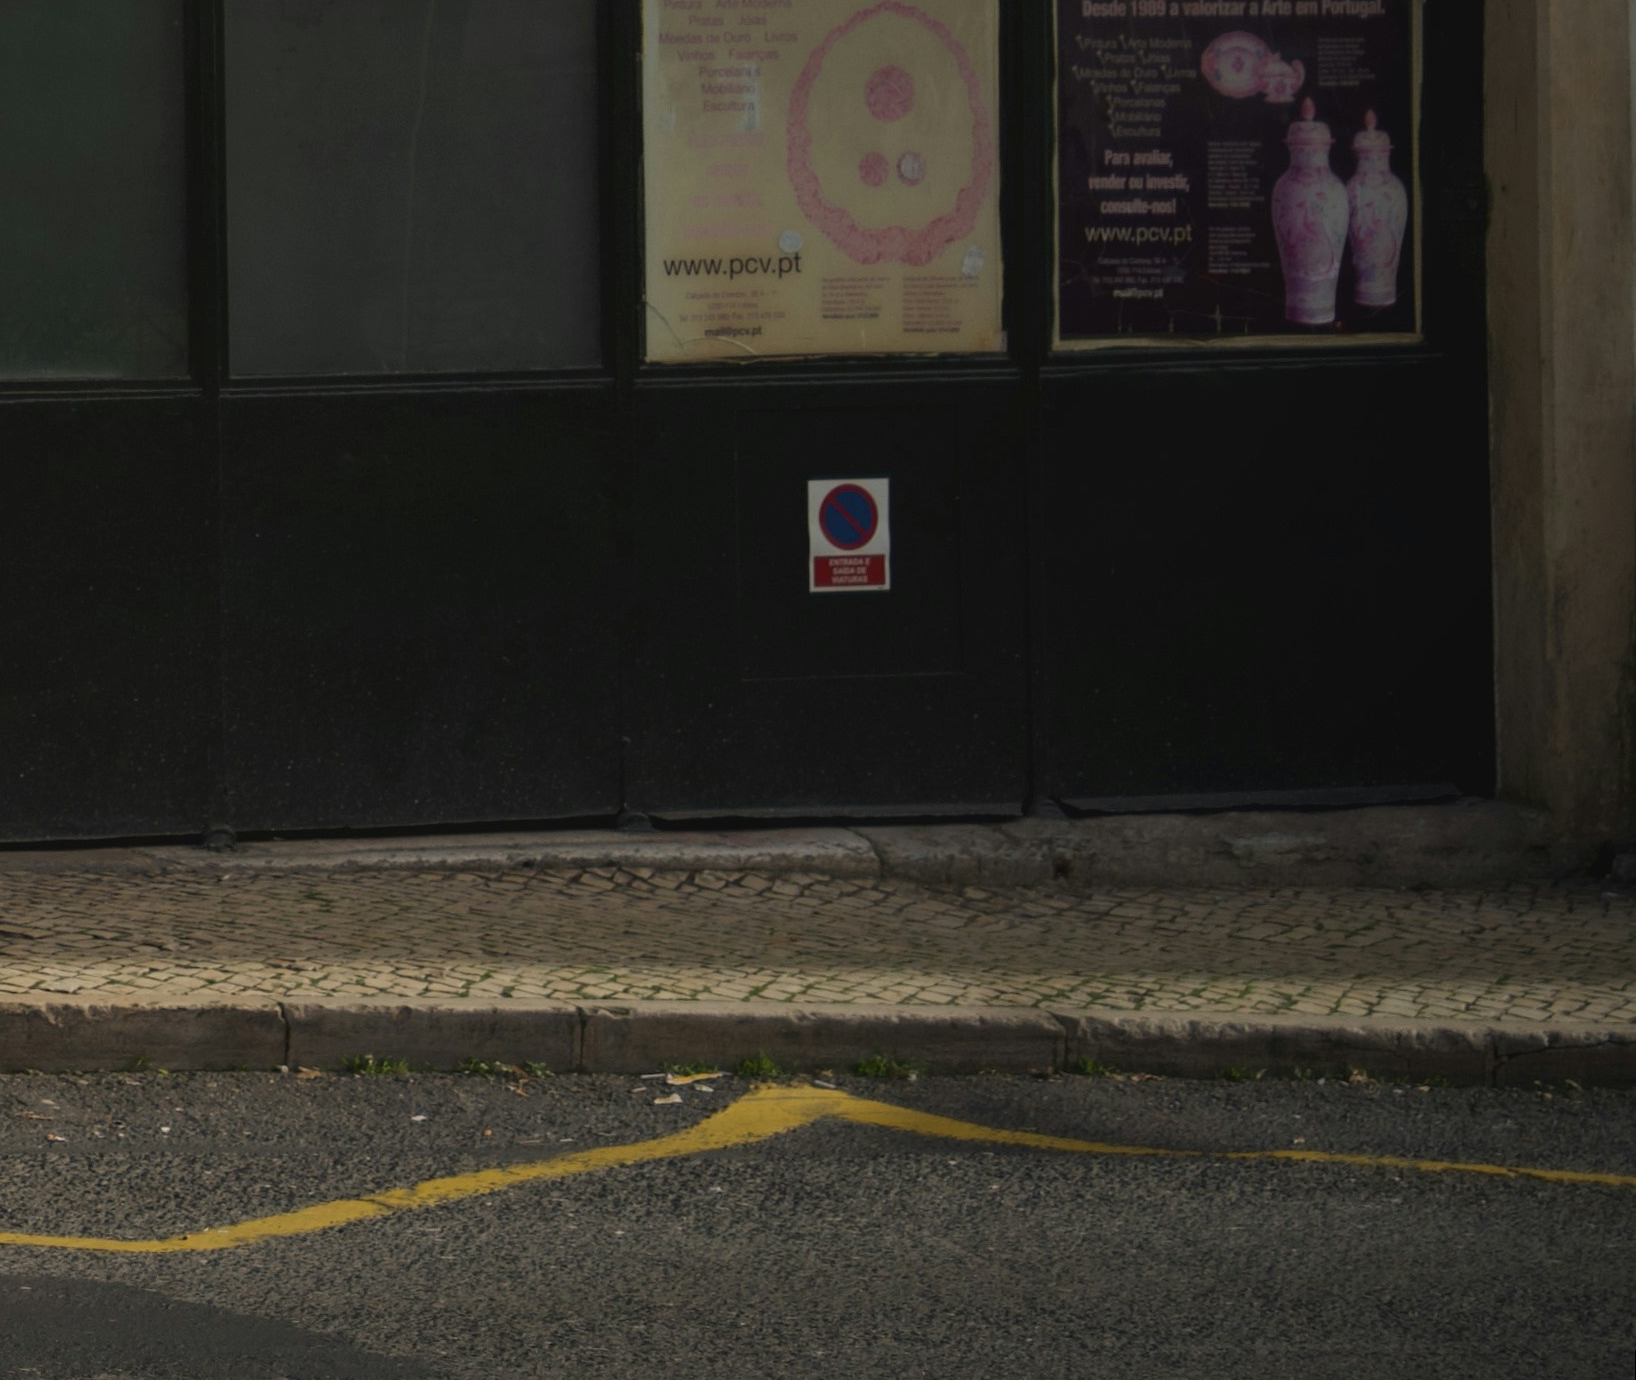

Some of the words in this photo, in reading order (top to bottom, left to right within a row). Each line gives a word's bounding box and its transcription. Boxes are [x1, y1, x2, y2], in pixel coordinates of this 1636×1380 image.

[1082, 0, 1127, 18] Desde
[1130, 0, 1167, 17] 1989
[1170, 2, 1180, 16] a
[1249, 1, 1258, 15] a
[1295, 0, 1318, 15] em
[706, 33, 721, 43] de
[723, 31, 752, 43] Ouro
[1104, 150, 1130, 166] Para
[1132, 149, 1174, 168] avaliar,
[1088, 174, 1127, 190] vender
[1128, 177, 1144, 190] ou
[1100, 198, 1177, 215] consulte-nos!
[1084, 224, 1193, 247] www.pcv.pt
[663, 251, 802, 281] www.pcv.pt
[828, 558, 863, 567] ENTRADA
